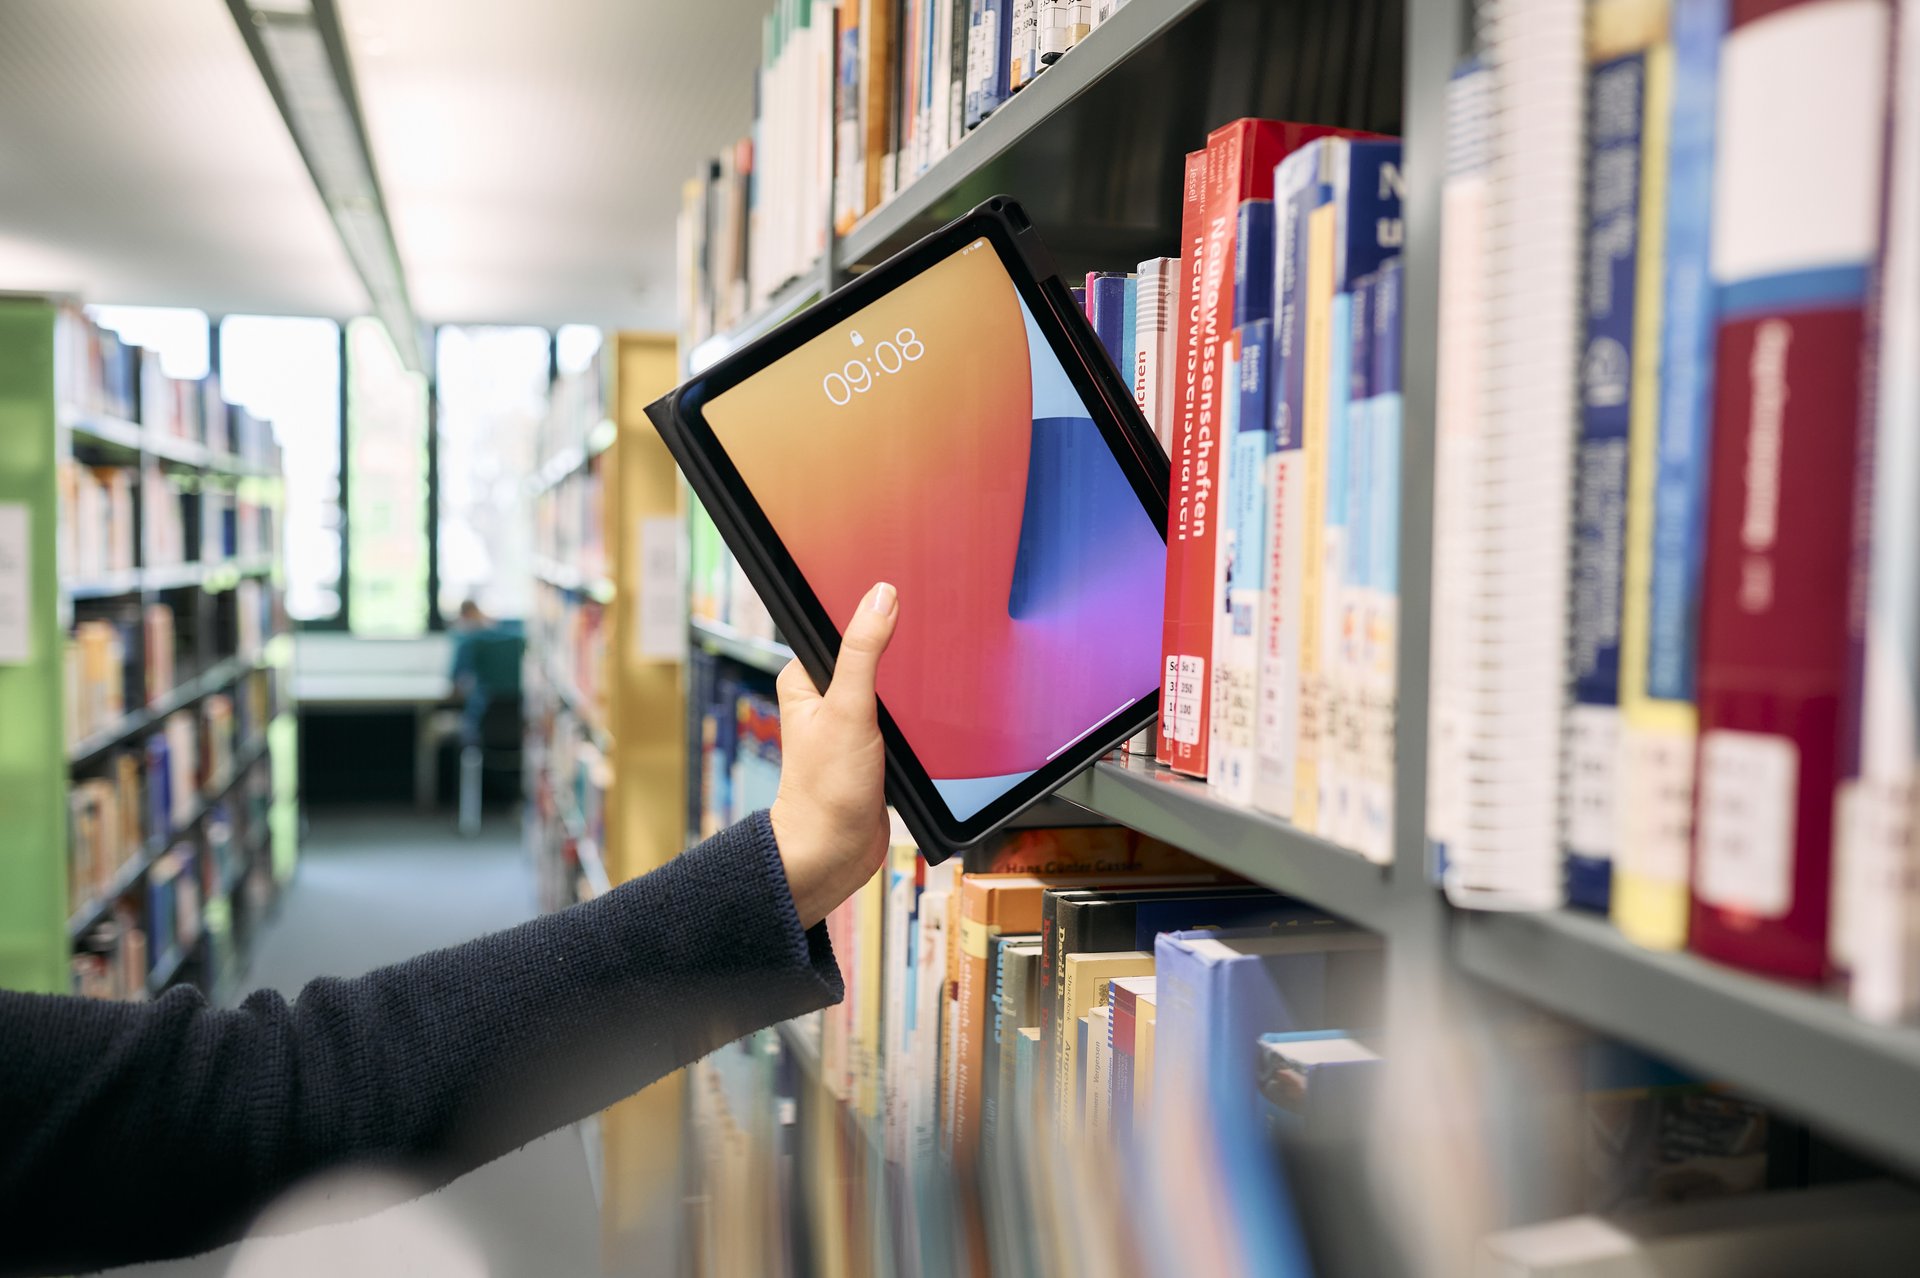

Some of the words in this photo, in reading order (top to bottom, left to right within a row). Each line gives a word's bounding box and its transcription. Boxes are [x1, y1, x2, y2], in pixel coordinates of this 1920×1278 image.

[1189, 167, 1199, 202] Jessell
[1209, 147, 1217, 183] Jessell
[823, 328, 925, 405] 09:08
[1192, 216, 1227, 537] Neurowissenschaften
[1058, 926, 1066, 978] David
[1065, 975, 1073, 1023] Shacklock
